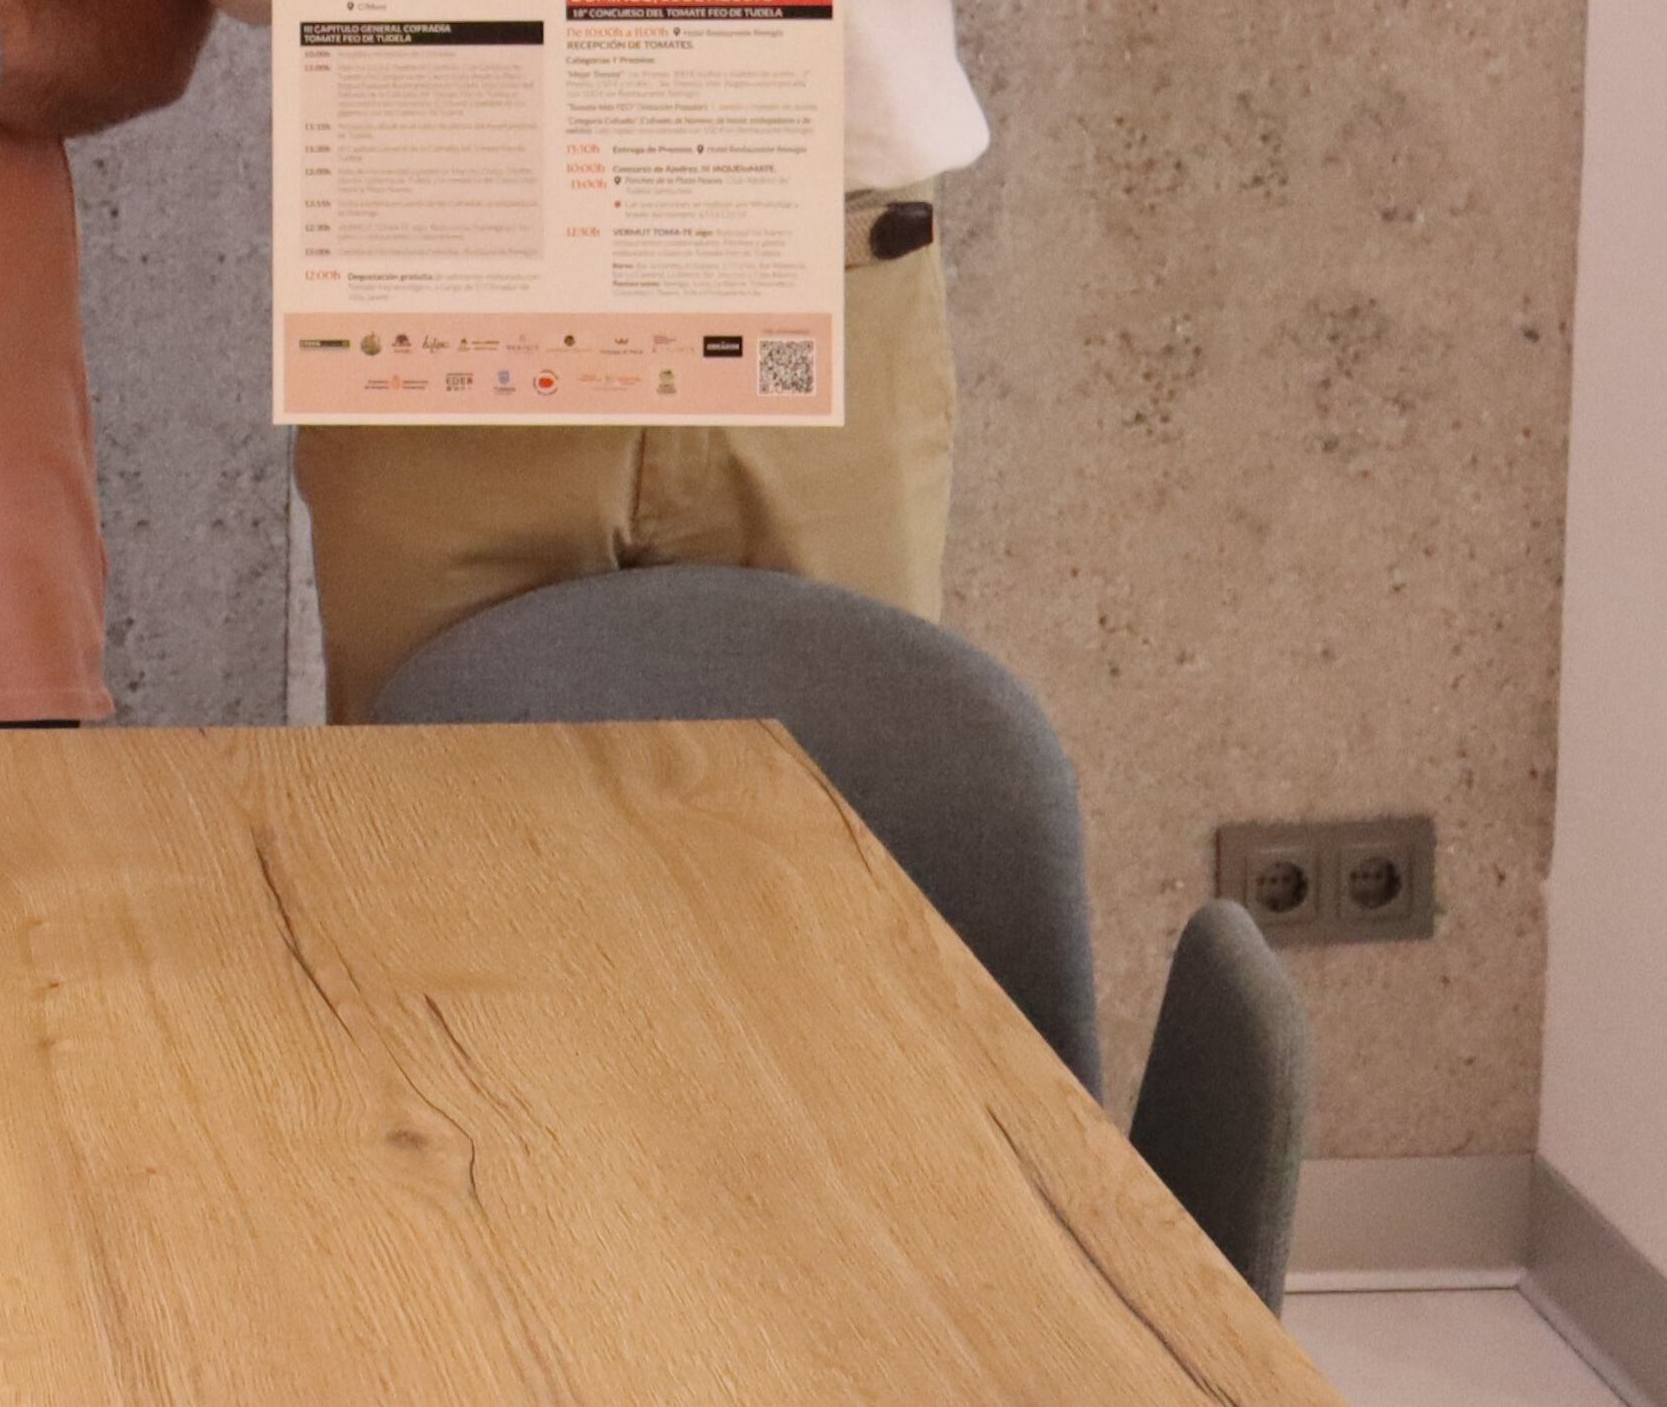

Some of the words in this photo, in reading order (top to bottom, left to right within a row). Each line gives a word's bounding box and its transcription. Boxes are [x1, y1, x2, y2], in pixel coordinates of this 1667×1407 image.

[589, 8, 645, 18] CONCURSO
[647, 8, 664, 18] DEL
[667, 8, 706, 18] TOMATE
[744, 7, 783, 17] TUDELA
[361, 24, 401, 33] GENERAL
[304, 34, 341, 44] TOMATE
[363, 34, 375, 43] DE
[377, 33, 412, 43] TUDELA
[567, 39, 626, 50] RECEPCIÓN
[628, 40, 642, 50] DE
